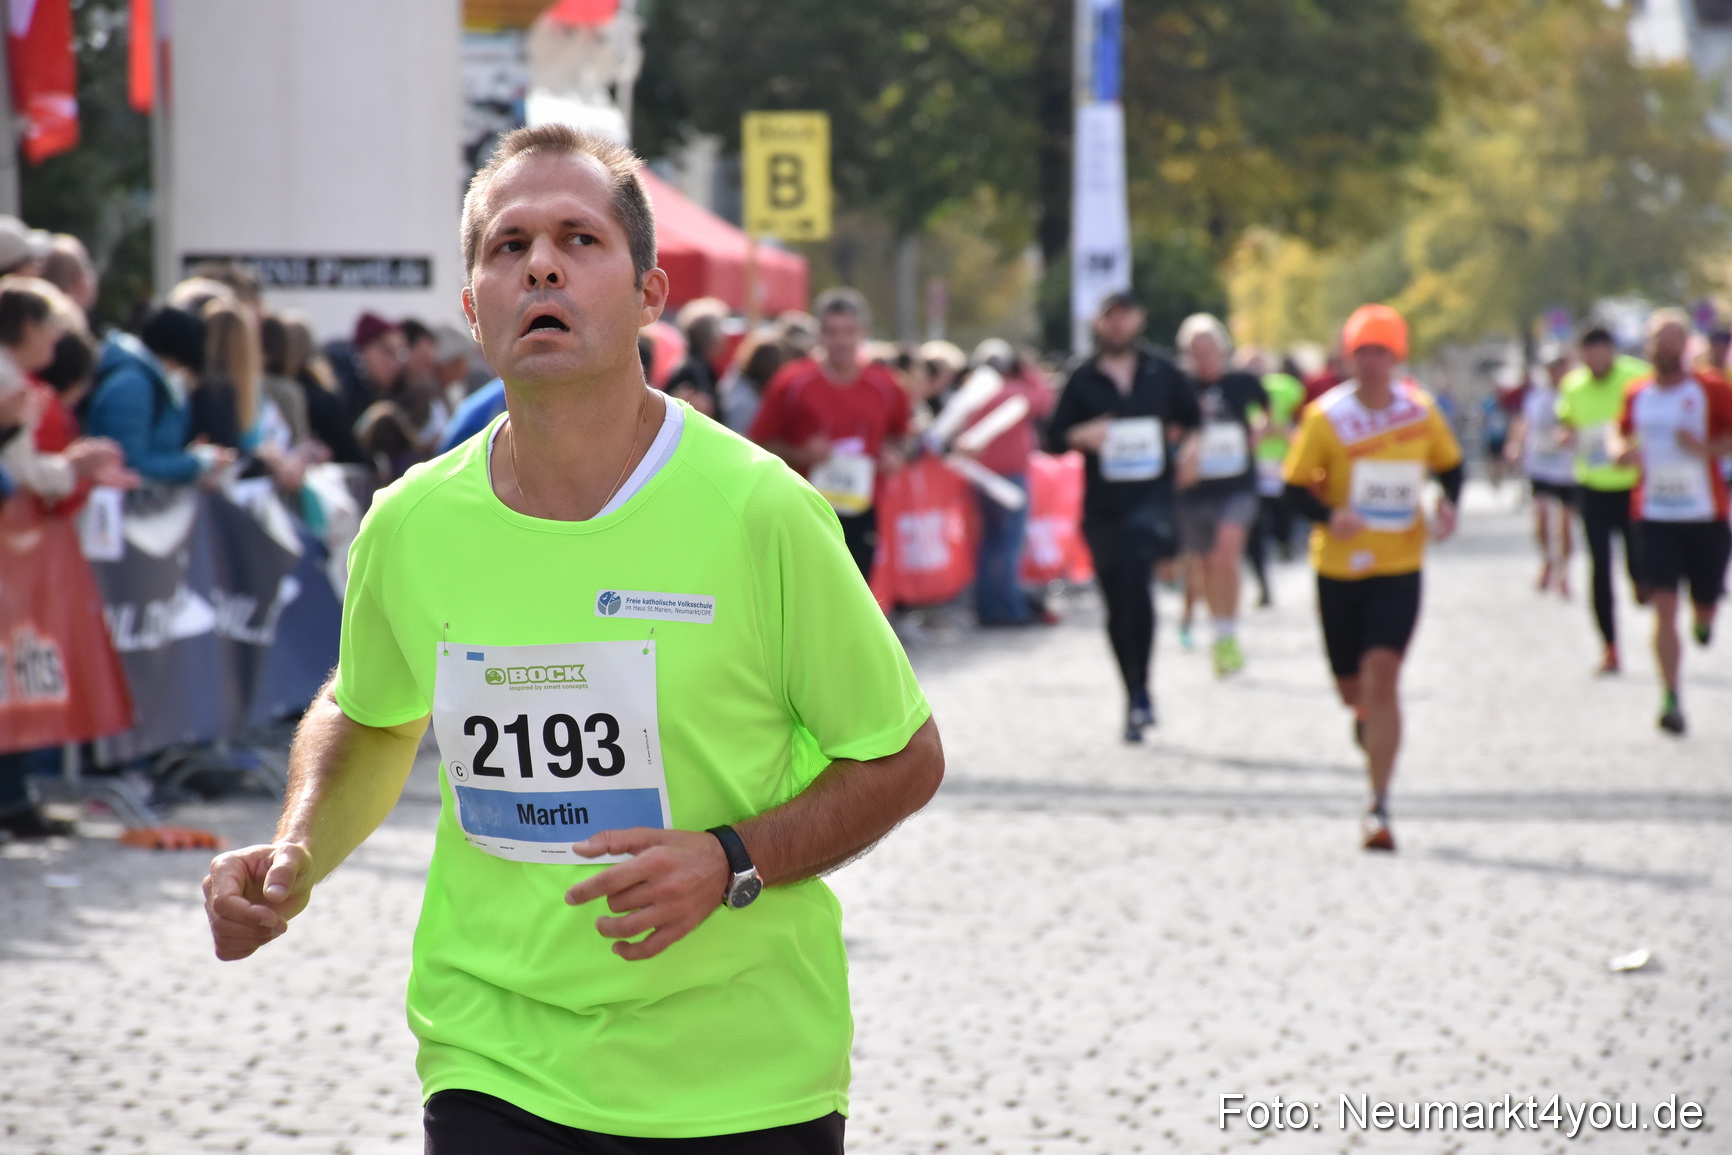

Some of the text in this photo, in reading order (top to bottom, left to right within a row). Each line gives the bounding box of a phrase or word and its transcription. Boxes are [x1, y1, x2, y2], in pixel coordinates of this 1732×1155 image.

[766, 153, 807, 211] B
[625, 597, 713, 609] Freie katholische Volksschule
[507, 664, 587, 685] BOCK
[463, 712, 626, 778] 2193
[455, 765, 464, 777] C
[516, 802, 590, 826] Martin
